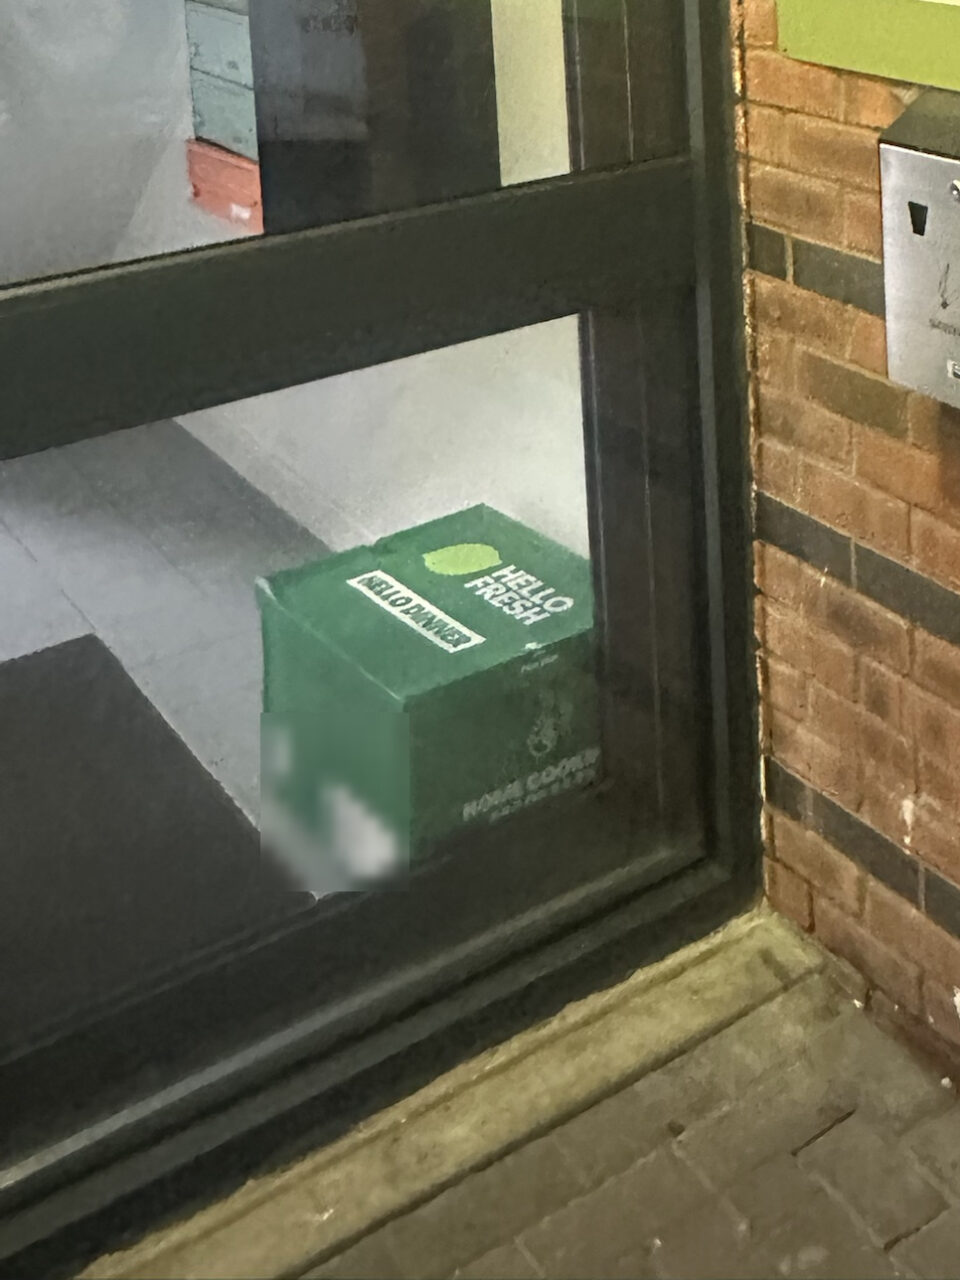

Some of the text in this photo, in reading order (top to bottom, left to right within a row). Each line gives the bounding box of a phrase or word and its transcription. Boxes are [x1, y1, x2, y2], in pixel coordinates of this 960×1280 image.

[357, 575, 472, 648] HELLO DINNER
[464, 576, 550, 626] FRESH
[492, 565, 574, 613] HELLO
